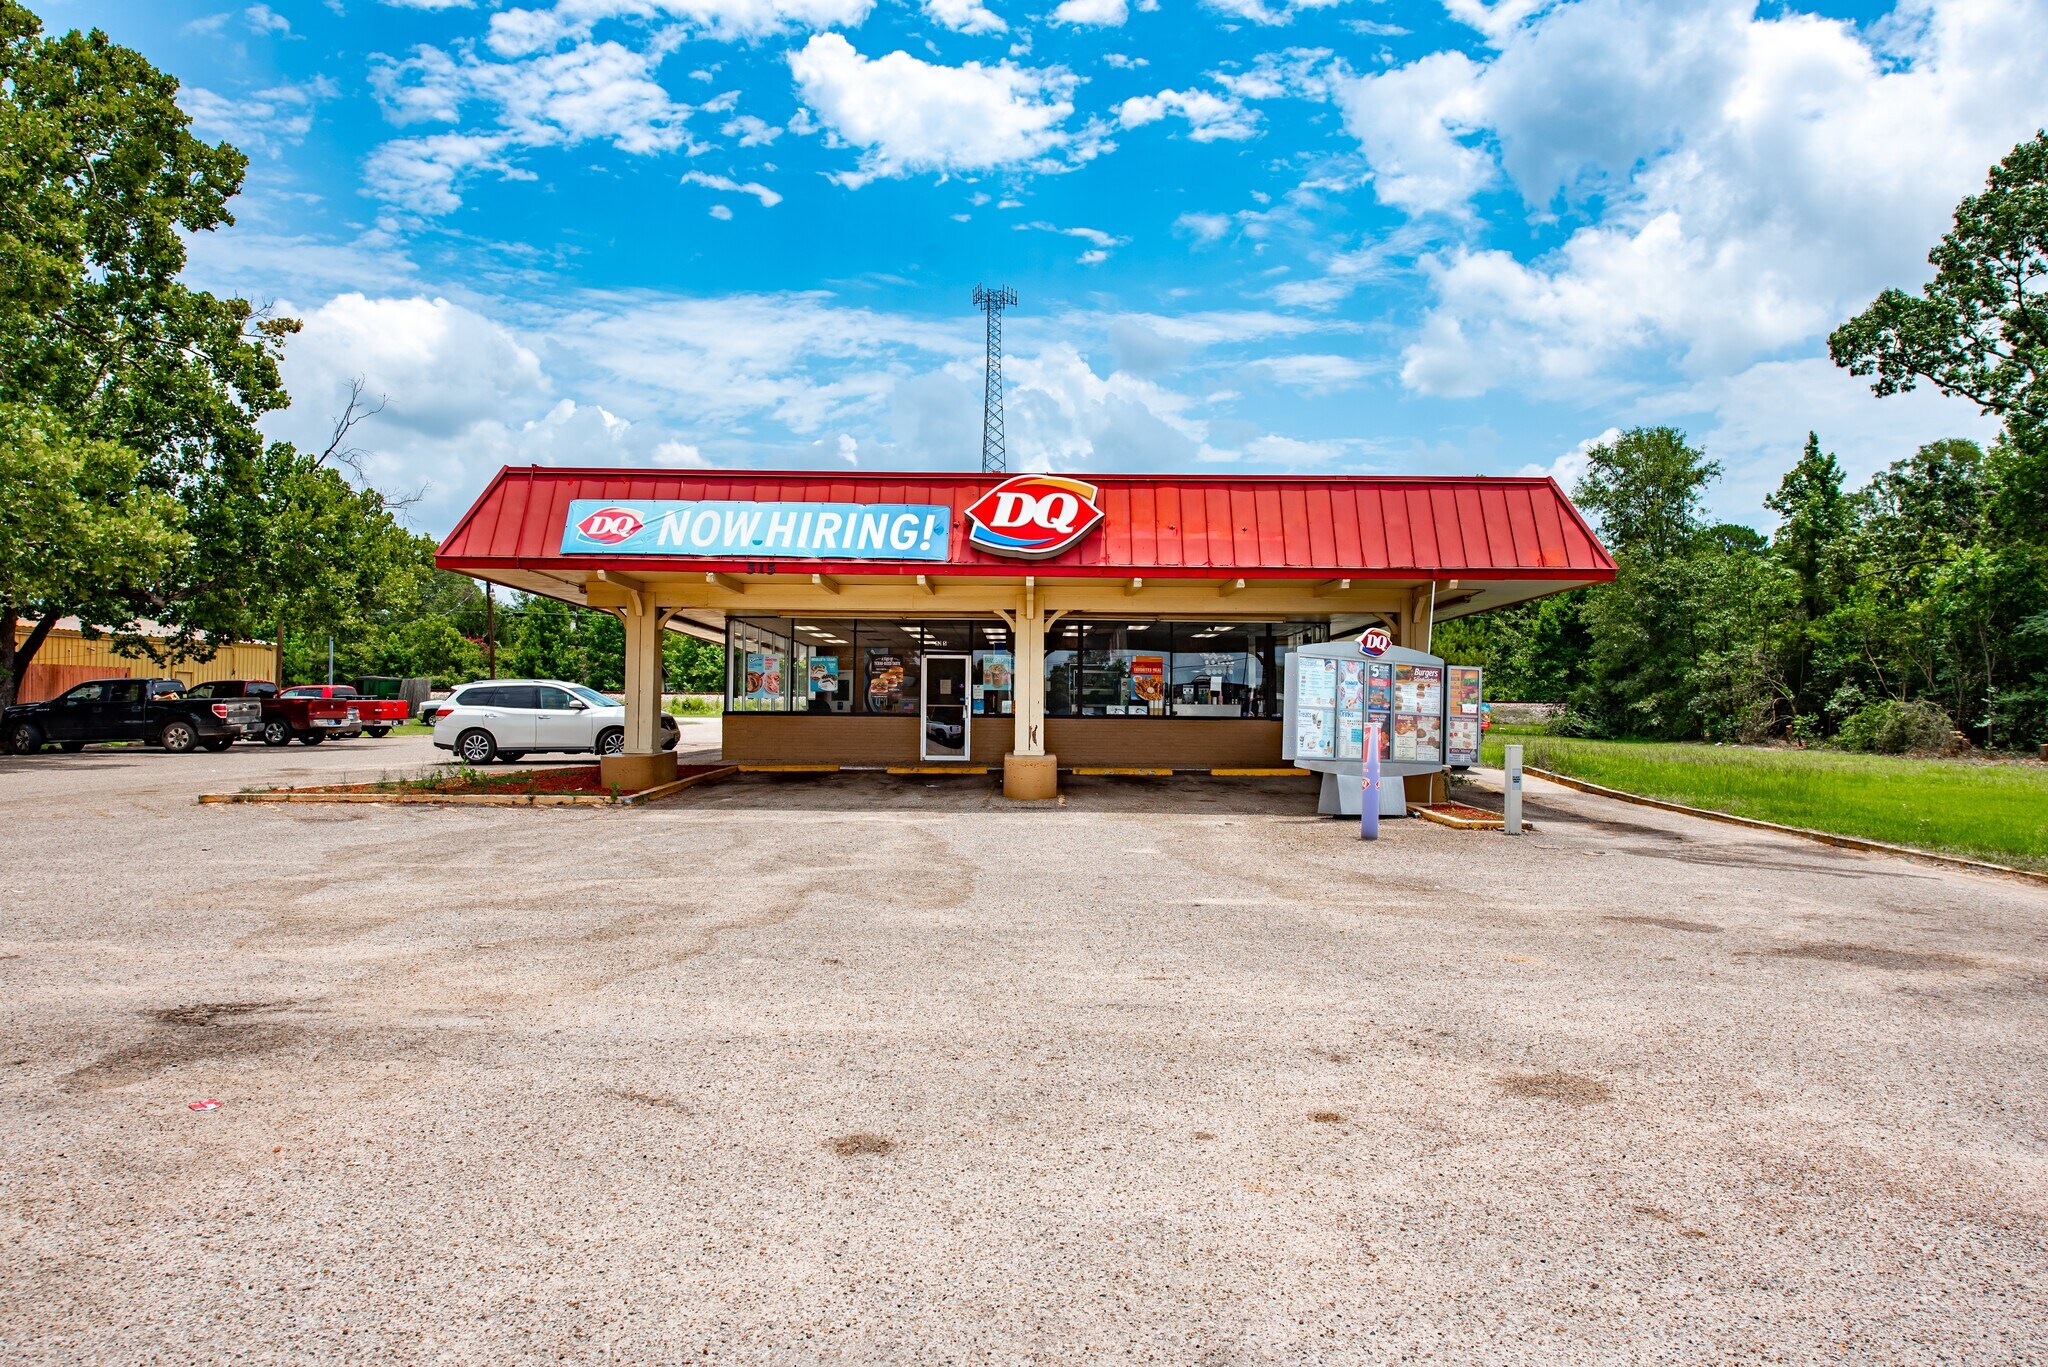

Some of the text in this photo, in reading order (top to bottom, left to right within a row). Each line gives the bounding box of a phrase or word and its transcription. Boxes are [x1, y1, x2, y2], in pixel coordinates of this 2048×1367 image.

[989, 491, 1079, 534] DQ
[587, 516, 635, 537] DQ
[656, 510, 936, 551] NOW HIRING!
[1365, 634, 1388, 651] DQ
[1414, 667, 1438, 678] Burgers
[1340, 710, 1354, 718] Drinks
